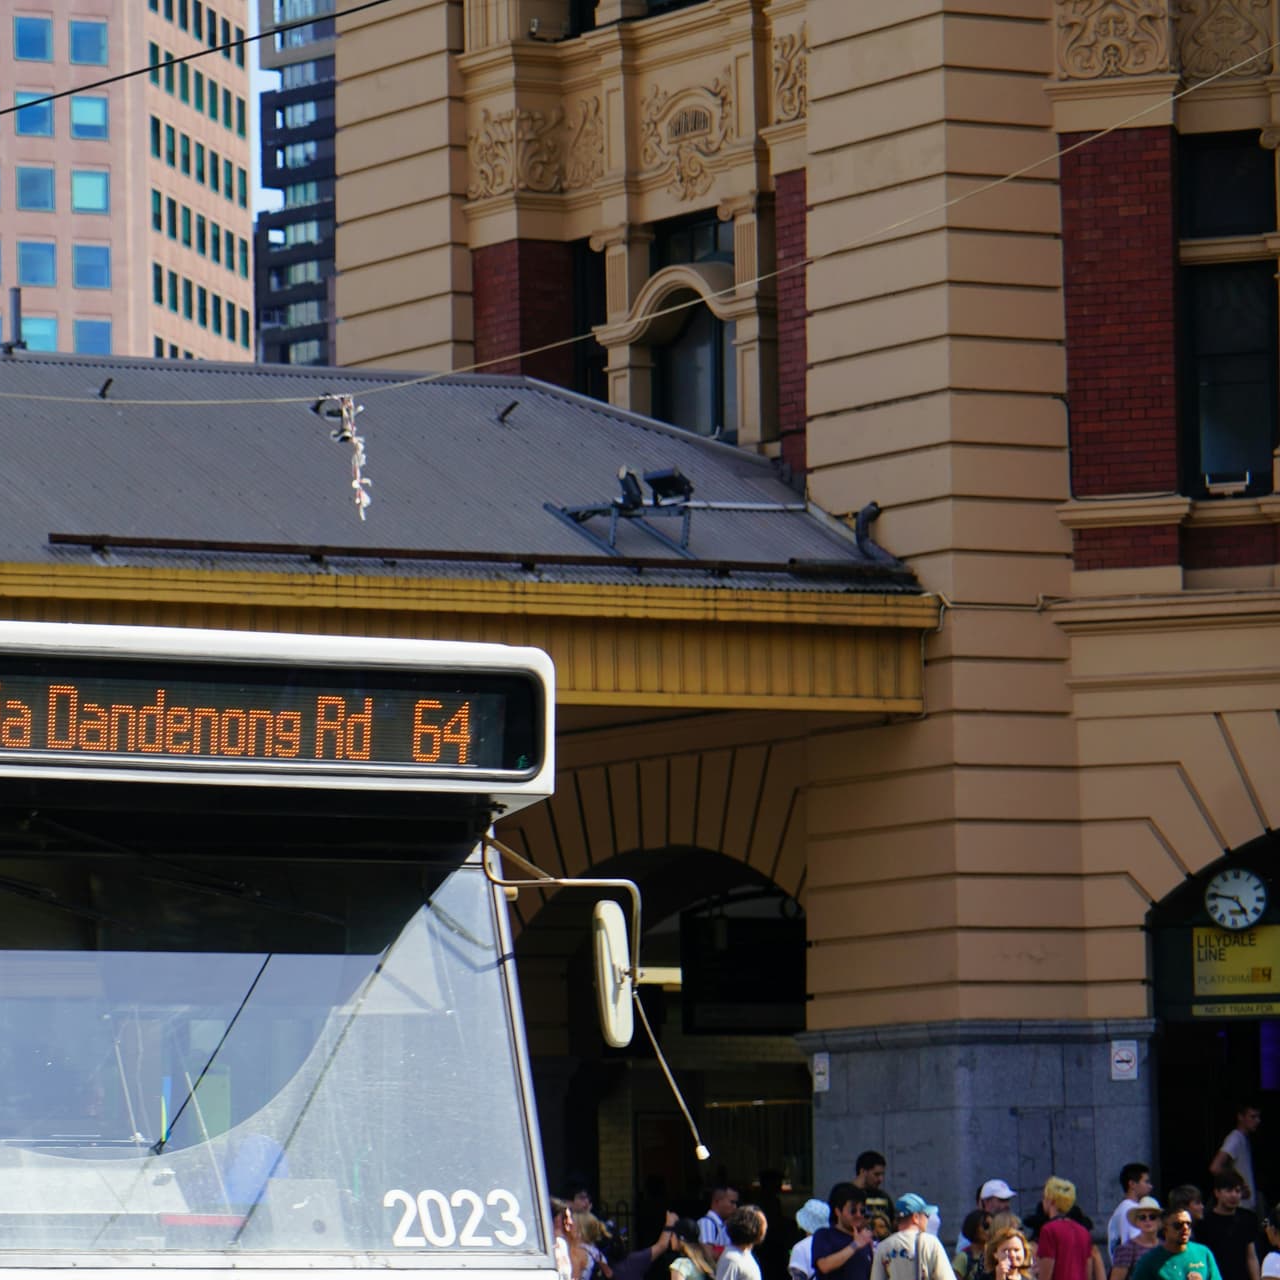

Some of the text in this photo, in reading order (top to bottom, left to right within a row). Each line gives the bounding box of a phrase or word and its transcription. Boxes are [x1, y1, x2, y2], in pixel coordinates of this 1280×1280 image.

[46, 684, 302, 758] Dandenong
[314, 695, 373, 761] Rd
[411, 699, 471, 764] 64
[1196, 948, 1227, 962] LINE
[1197, 933, 1256, 948] LILYDALE
[383, 1188, 528, 1247] 2023
